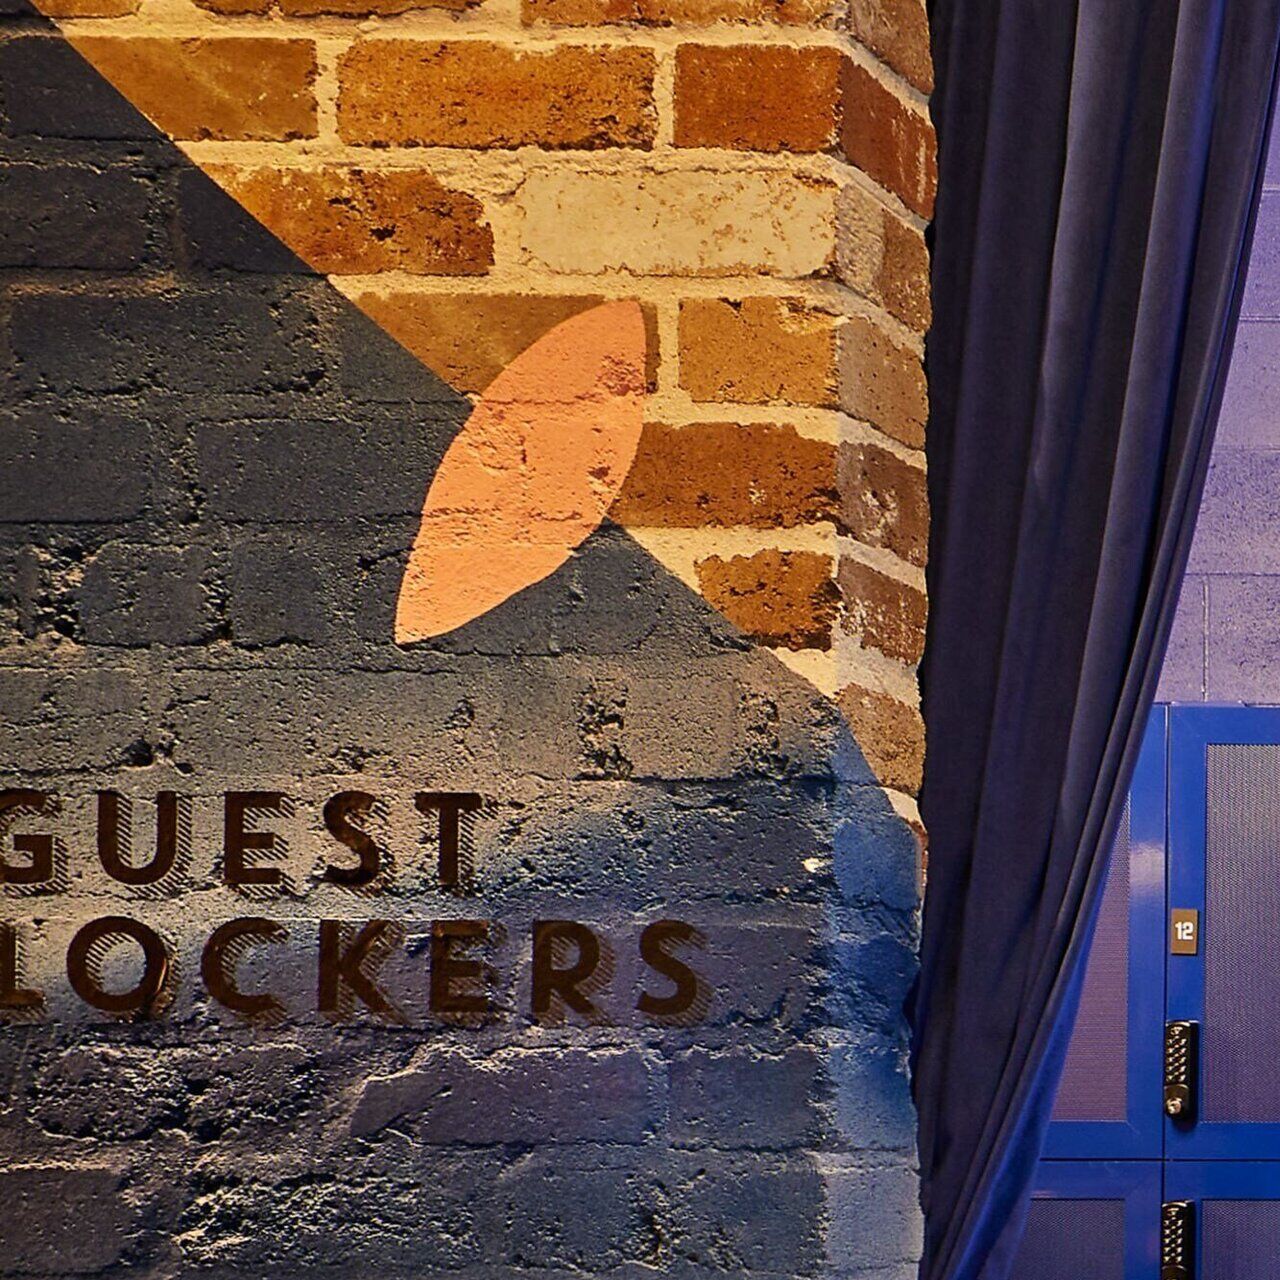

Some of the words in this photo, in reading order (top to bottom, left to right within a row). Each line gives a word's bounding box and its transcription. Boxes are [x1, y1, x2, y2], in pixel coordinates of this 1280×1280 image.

[0, 789, 485, 889] GUEST
[0, 915, 700, 1016] LOCKERS
[1174, 921, 1194, 941] 12
